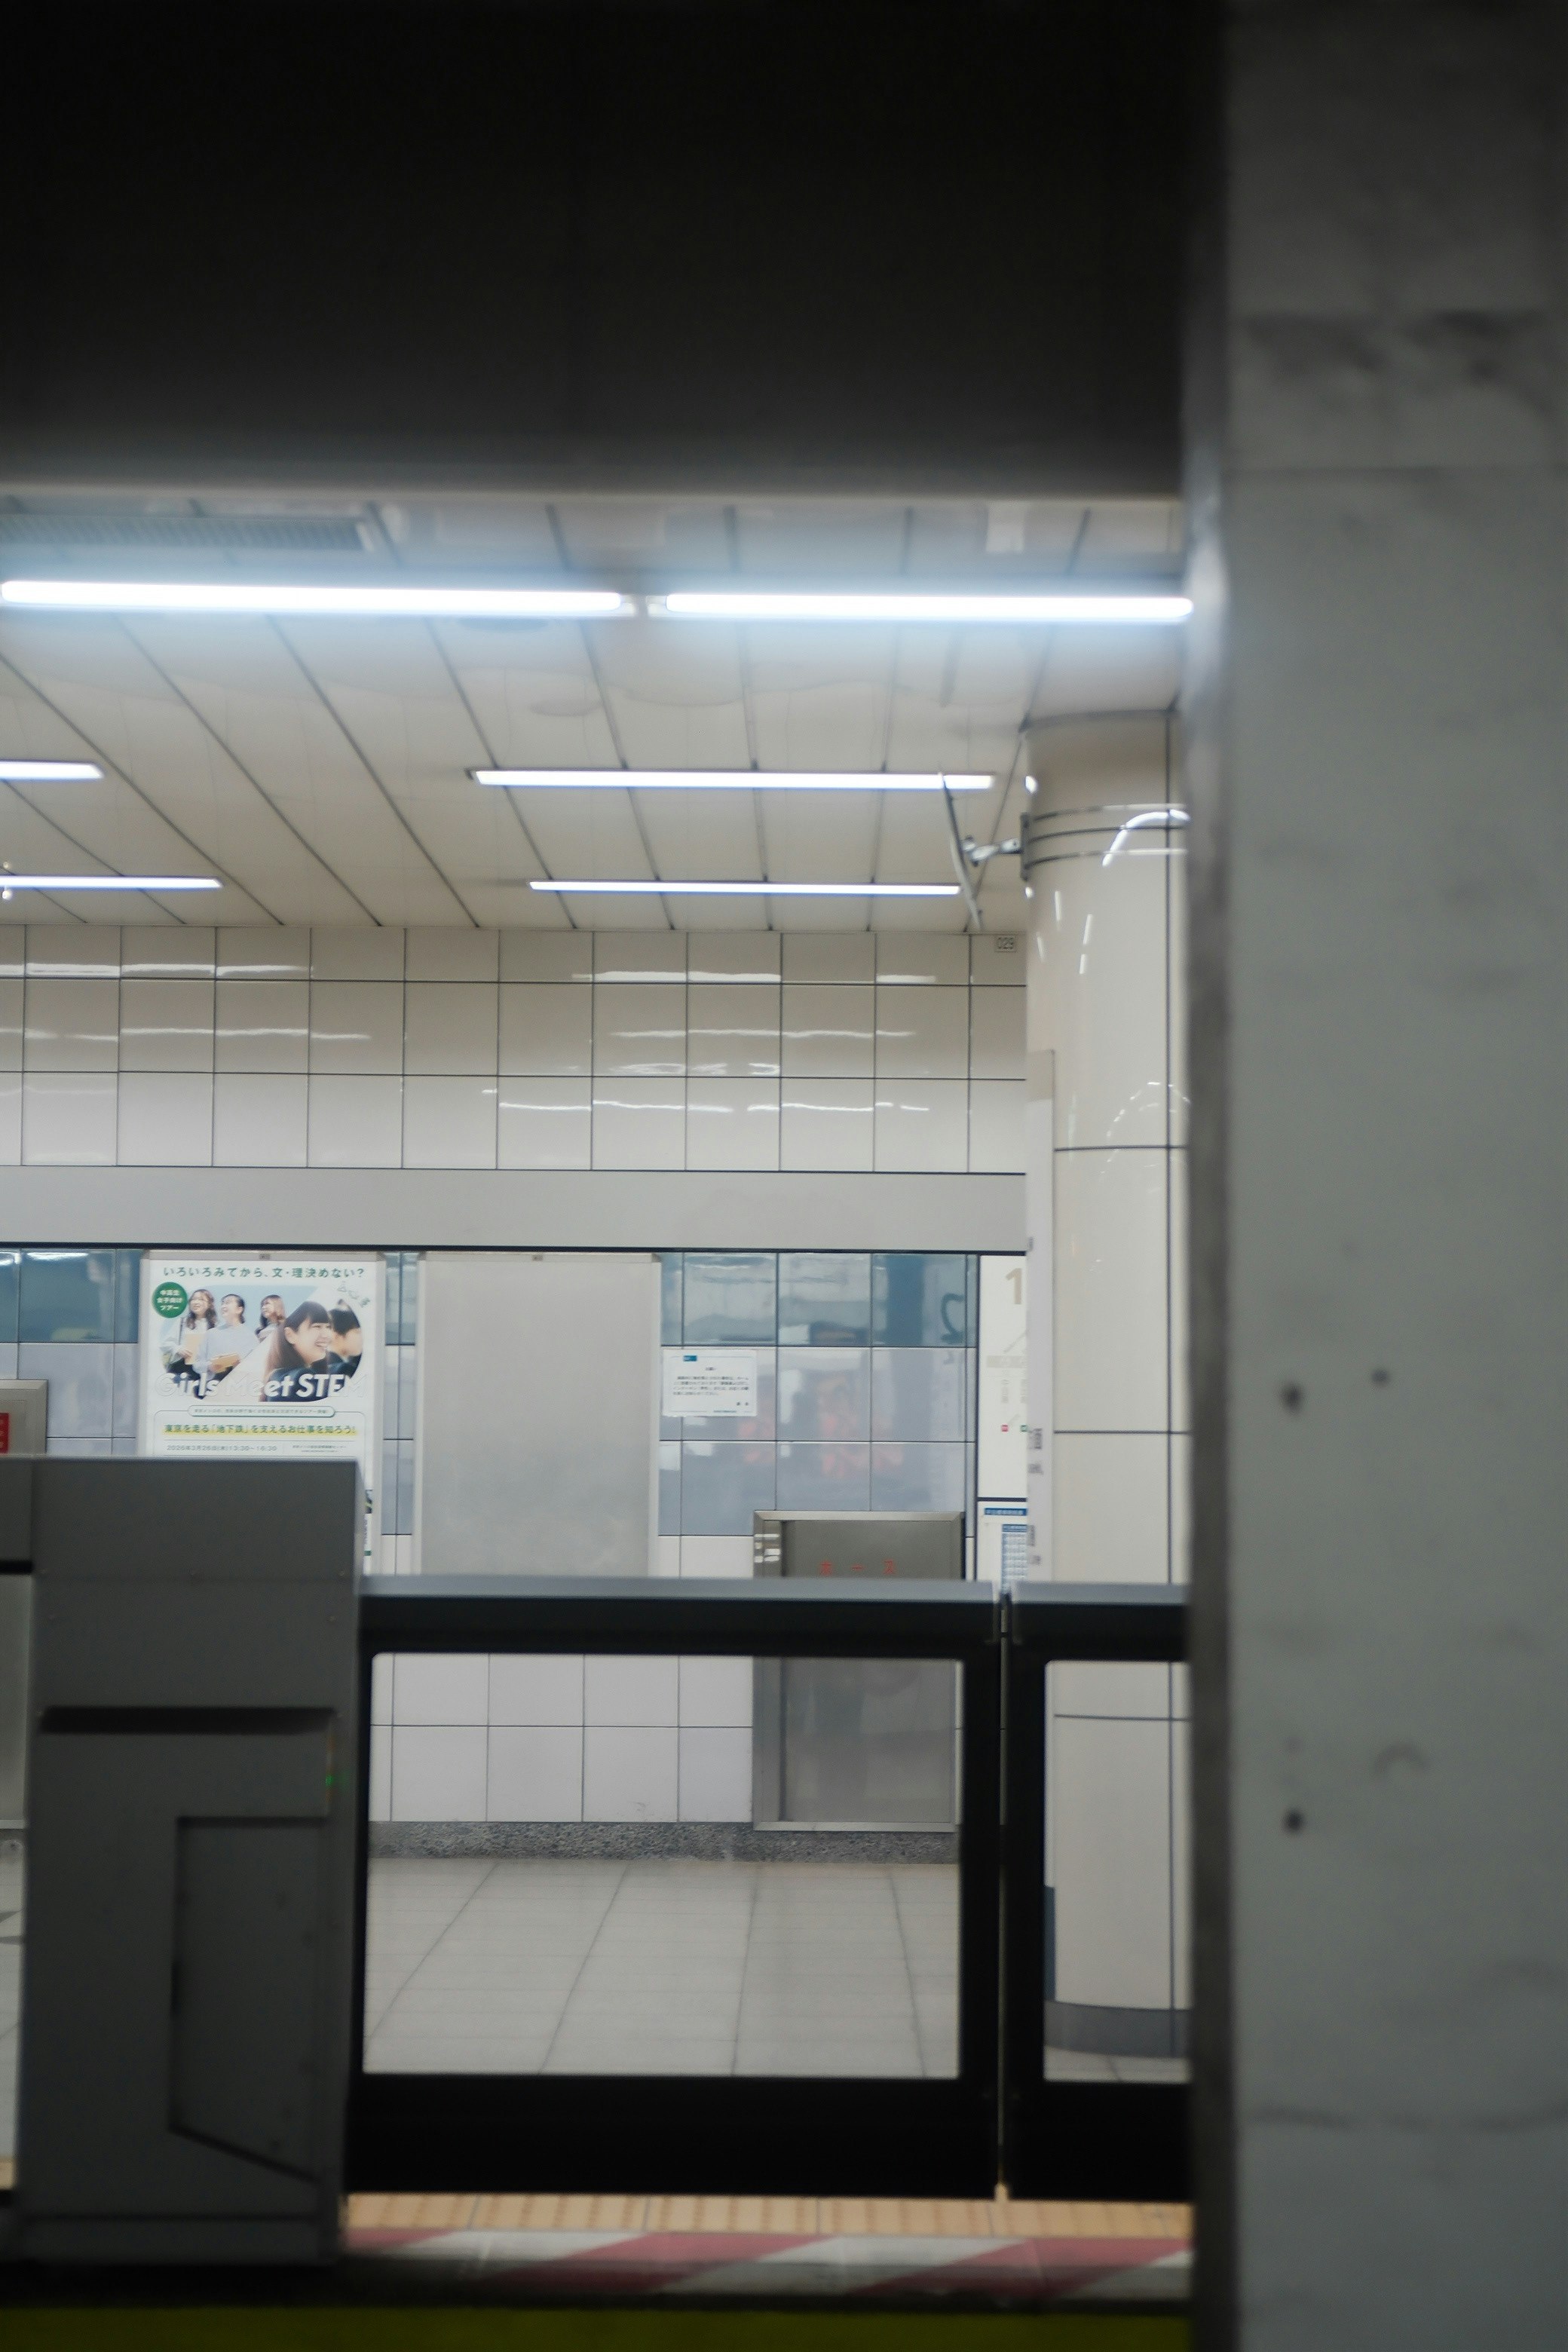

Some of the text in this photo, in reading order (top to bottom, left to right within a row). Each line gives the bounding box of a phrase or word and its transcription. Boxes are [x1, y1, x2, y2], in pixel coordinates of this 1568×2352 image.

[163, 1266, 365, 1279] いろいろみてから、文・理決めない？
[155, 1371, 219, 1397] Girls
[295, 1372, 369, 1398] STEM
